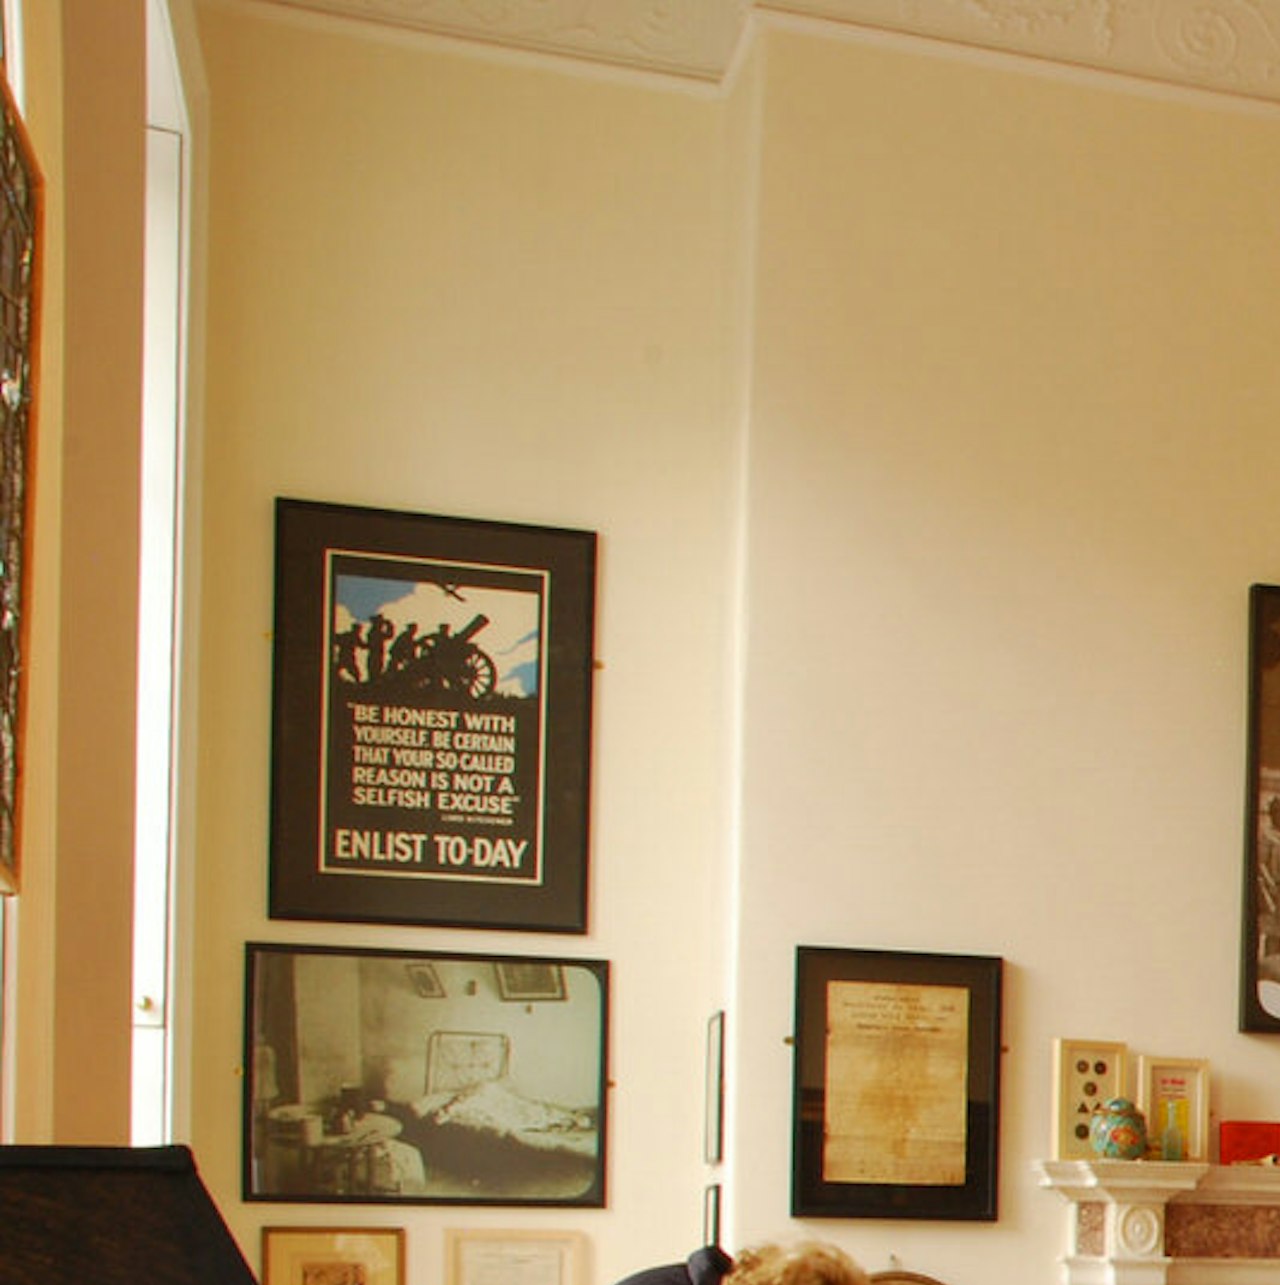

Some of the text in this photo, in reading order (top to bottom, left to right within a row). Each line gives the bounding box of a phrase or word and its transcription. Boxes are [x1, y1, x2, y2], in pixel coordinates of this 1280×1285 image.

[383, 706, 459, 729] HONEST
[464, 711, 515, 733] WITH
[432, 730, 451, 748] BE
[453, 732, 515, 753] CERTAIN
[353, 744, 390, 765] THAT
[392, 748, 434, 769] YOUR
[353, 766, 514, 795] REASON IS NOT A
[353, 786, 431, 809] SELFISH
[335, 828, 528, 869] ENLIST TO-DAY
